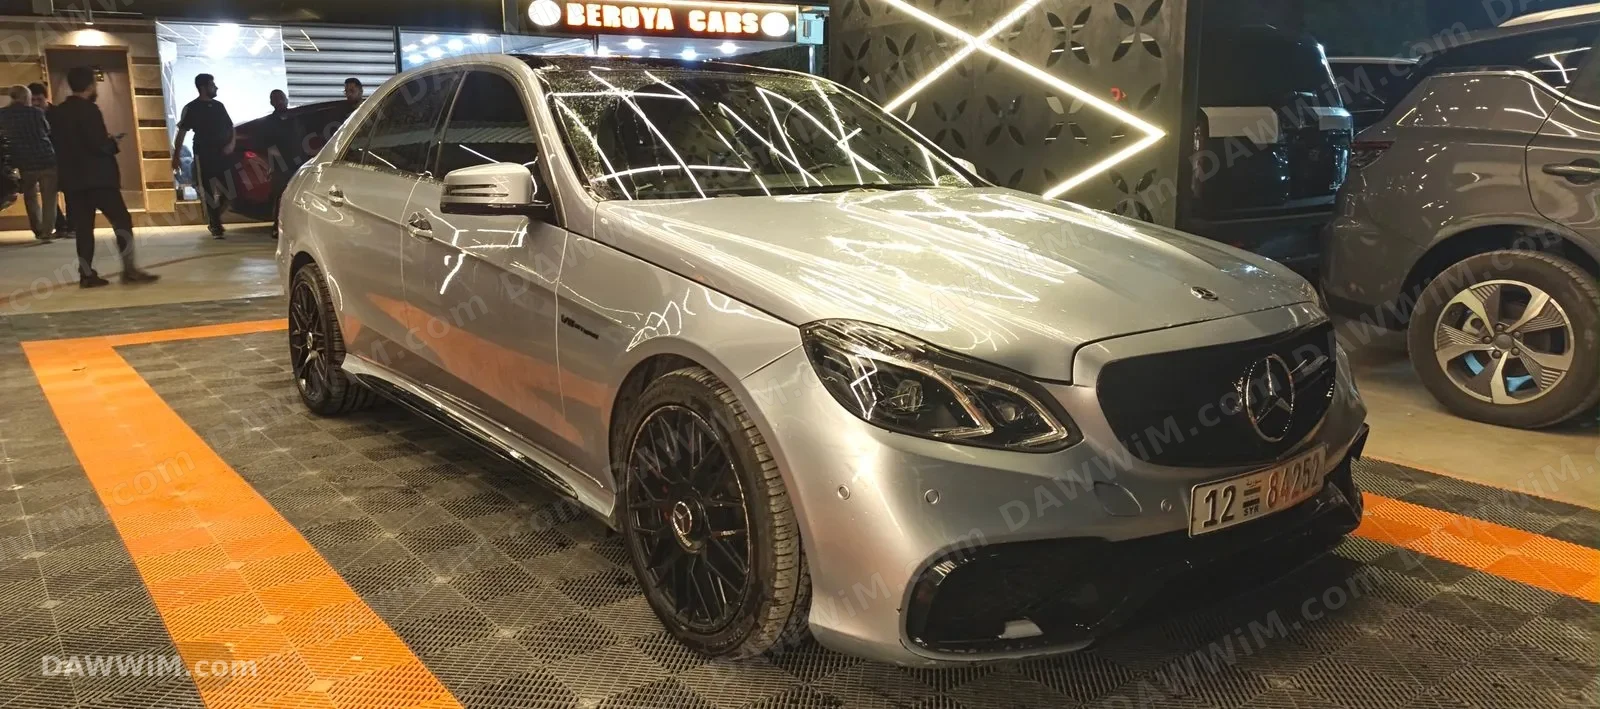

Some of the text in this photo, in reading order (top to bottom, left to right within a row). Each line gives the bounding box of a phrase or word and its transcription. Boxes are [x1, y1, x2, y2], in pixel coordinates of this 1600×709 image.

[567, 3, 758, 33] BEROYA CARS
[1202, 452, 1321, 528] 12 84252
